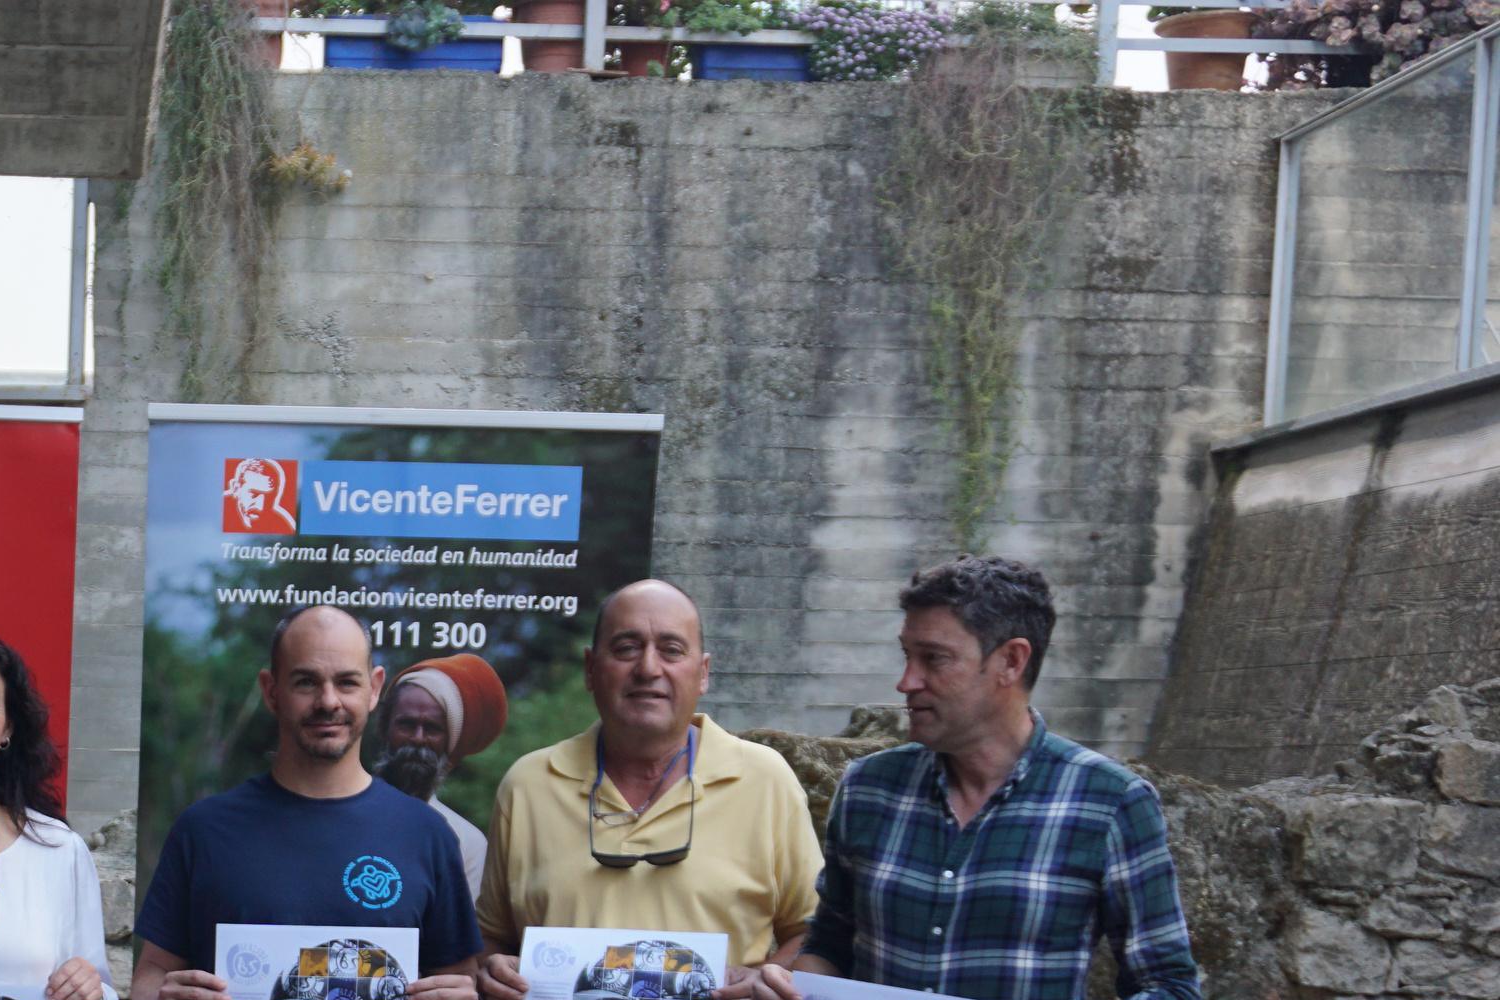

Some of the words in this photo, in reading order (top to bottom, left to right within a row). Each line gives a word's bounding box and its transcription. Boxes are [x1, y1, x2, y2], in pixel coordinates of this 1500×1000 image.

[313, 480, 568, 518] VicenteFerrer
[221, 541, 327, 564] Transforma
[332, 543, 350, 562] la
[354, 544, 438, 564] sociedad
[441, 550, 465, 566] en
[469, 546, 579, 568] humanidad
[217, 584, 579, 616] www.fundacionvicenteferrer.org
[370, 620, 421, 647] 111
[432, 620, 487, 649] 300
